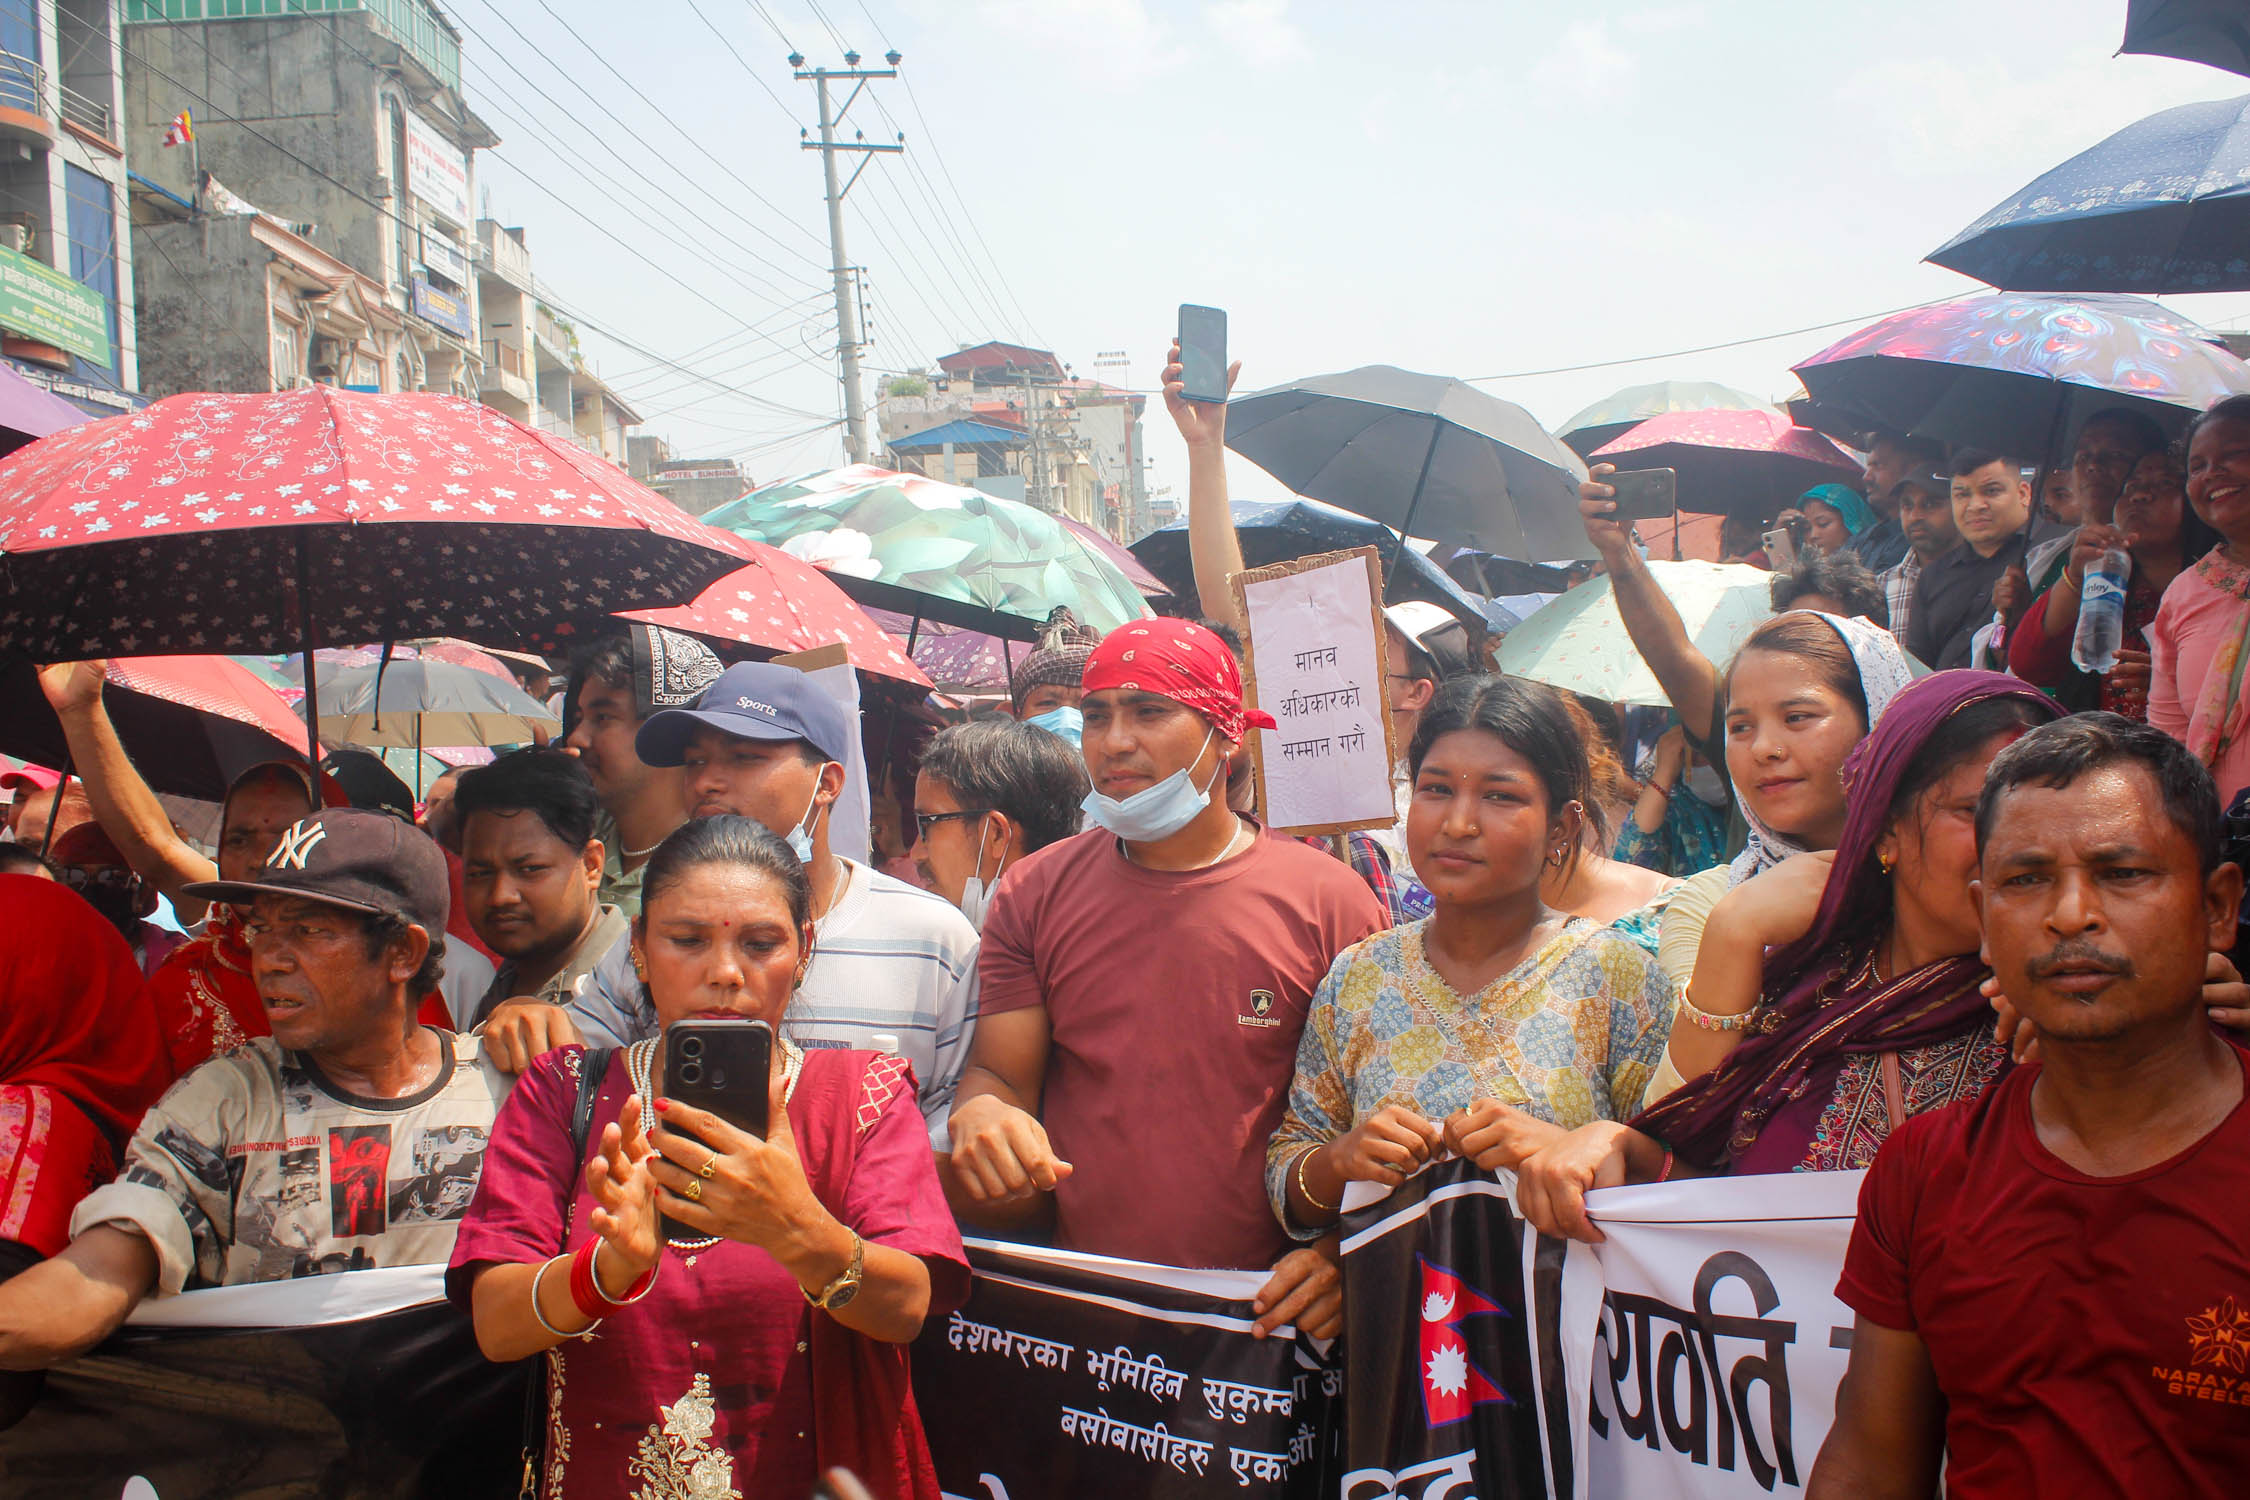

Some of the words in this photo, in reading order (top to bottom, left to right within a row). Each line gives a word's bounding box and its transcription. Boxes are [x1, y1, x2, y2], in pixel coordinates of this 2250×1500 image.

[664, 471, 693, 479] HOTEL
[698, 469, 738, 478] SUNSHINE
[1294, 646, 1337, 671] मानव
[736, 696, 778, 717] Sports
[1280, 681, 1360, 718] अधिकारको
[1282, 737, 1331, 761] सम्मान
[1338, 724, 1366, 753] गरौं
[266, 819, 327, 871] NY
[1238, 1014, 1281, 1028] Lamborghini
[949, 1310, 1075, 1372] देशभरका
[1087, 1346, 1189, 1404] भूमिहिन
